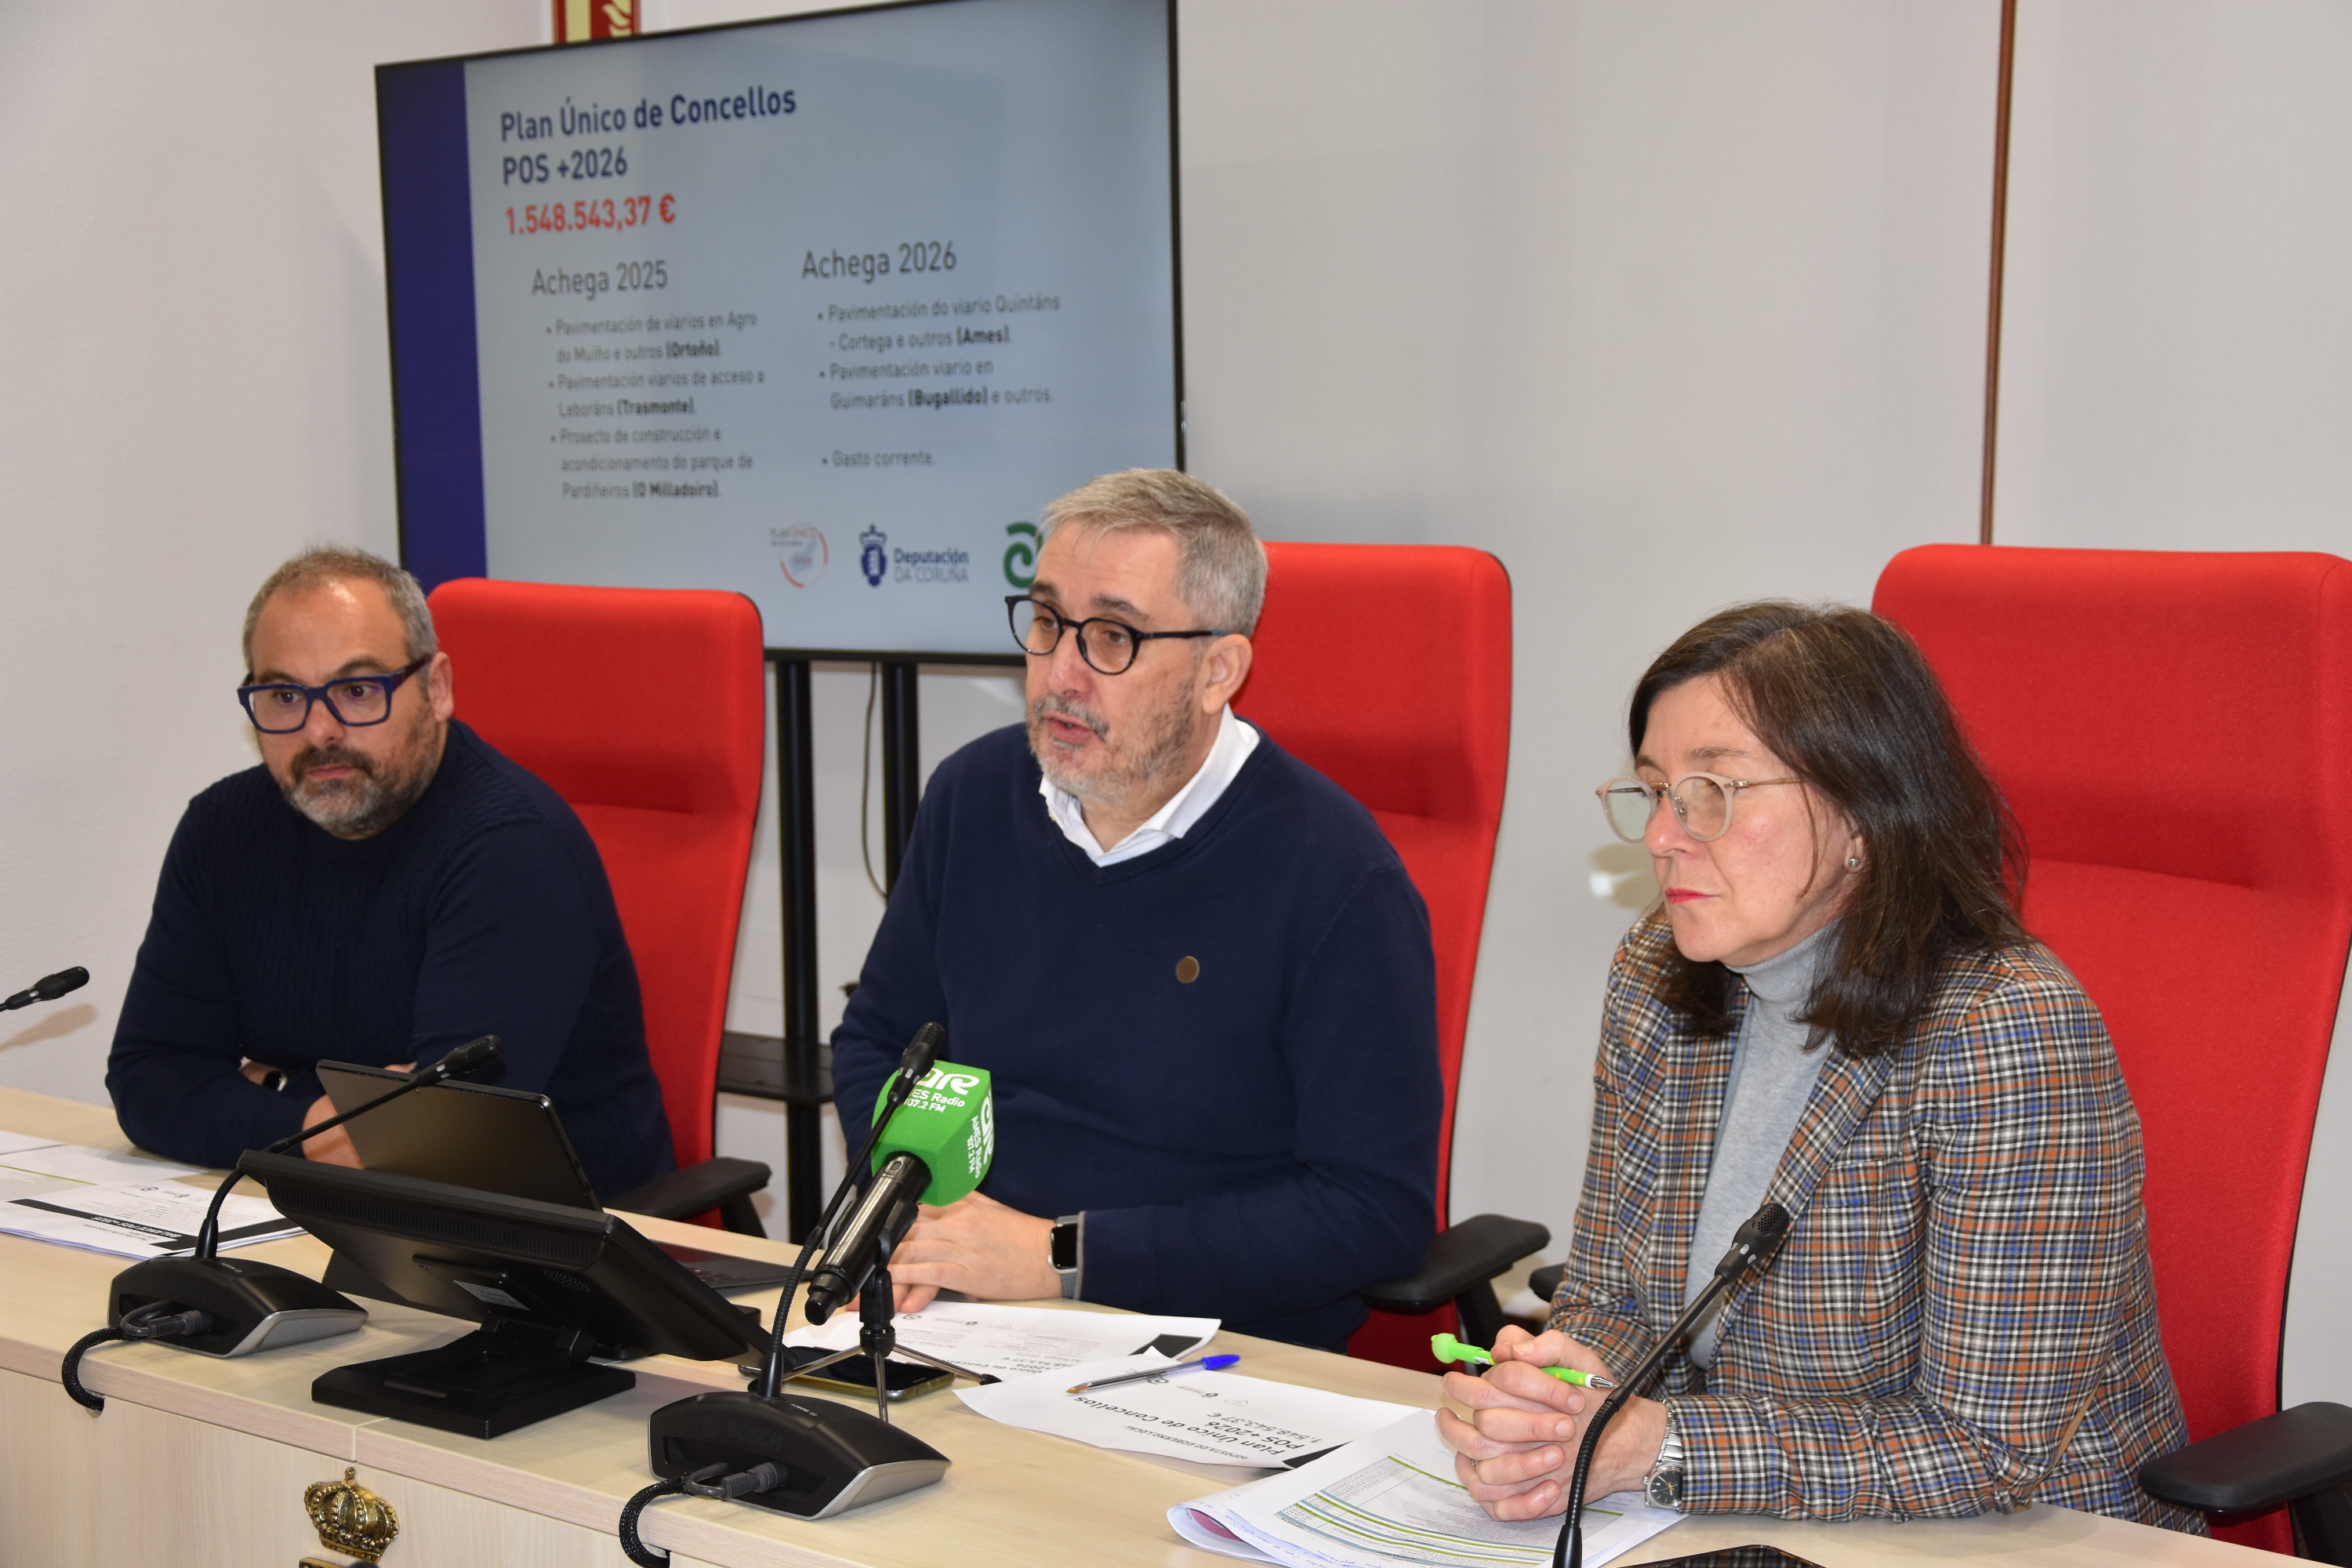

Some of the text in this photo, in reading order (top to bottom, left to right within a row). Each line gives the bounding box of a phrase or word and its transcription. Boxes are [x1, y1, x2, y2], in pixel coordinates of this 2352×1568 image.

[502, 85, 796, 142] Plan Único de Concellos
[503, 146, 628, 186] POS +2026
[505, 194, 676, 235] 1.548.543,37 €
[801, 239, 957, 285] Achega 2026
[532, 260, 668, 301] Achega 2025
[828, 291, 1061, 321] Pavimentación do viario Quintáns
[708, 314, 724, 328] en
[726, 310, 757, 331] Agro
[613, 347, 621, 360] e
[624, 344, 662, 360] outros
[838, 332, 893, 354] Cortega
[896, 335, 905, 349] e
[908, 331, 953, 347] outros
[691, 368, 707, 386] de
[710, 369, 754, 385] acceso
[757, 369, 765, 384] a
[829, 358, 993, 380] Pavimentación viario en
[830, 389, 905, 410] Guimaráns
[908, 386, 988, 411] (Bugallido)
[991, 390, 1000, 404] e
[614, 427, 629, 444] de
[713, 428, 722, 441] e
[690, 456, 735, 473] parque
[737, 451, 753, 468] de
[832, 449, 871, 467] Gasto
[894, 546, 969, 568] Deputación
[894, 567, 969, 583] DA CORUÑA
[928, 1102, 946, 1112] FM
[931, 1092, 965, 1107] Radio
[1073, 1396, 1286, 1455] Plan Único de Concellos
[1205, 1421, 1305, 1450] POS +2026
[1221, 1414, 1322, 1443] 1.548.543,37
